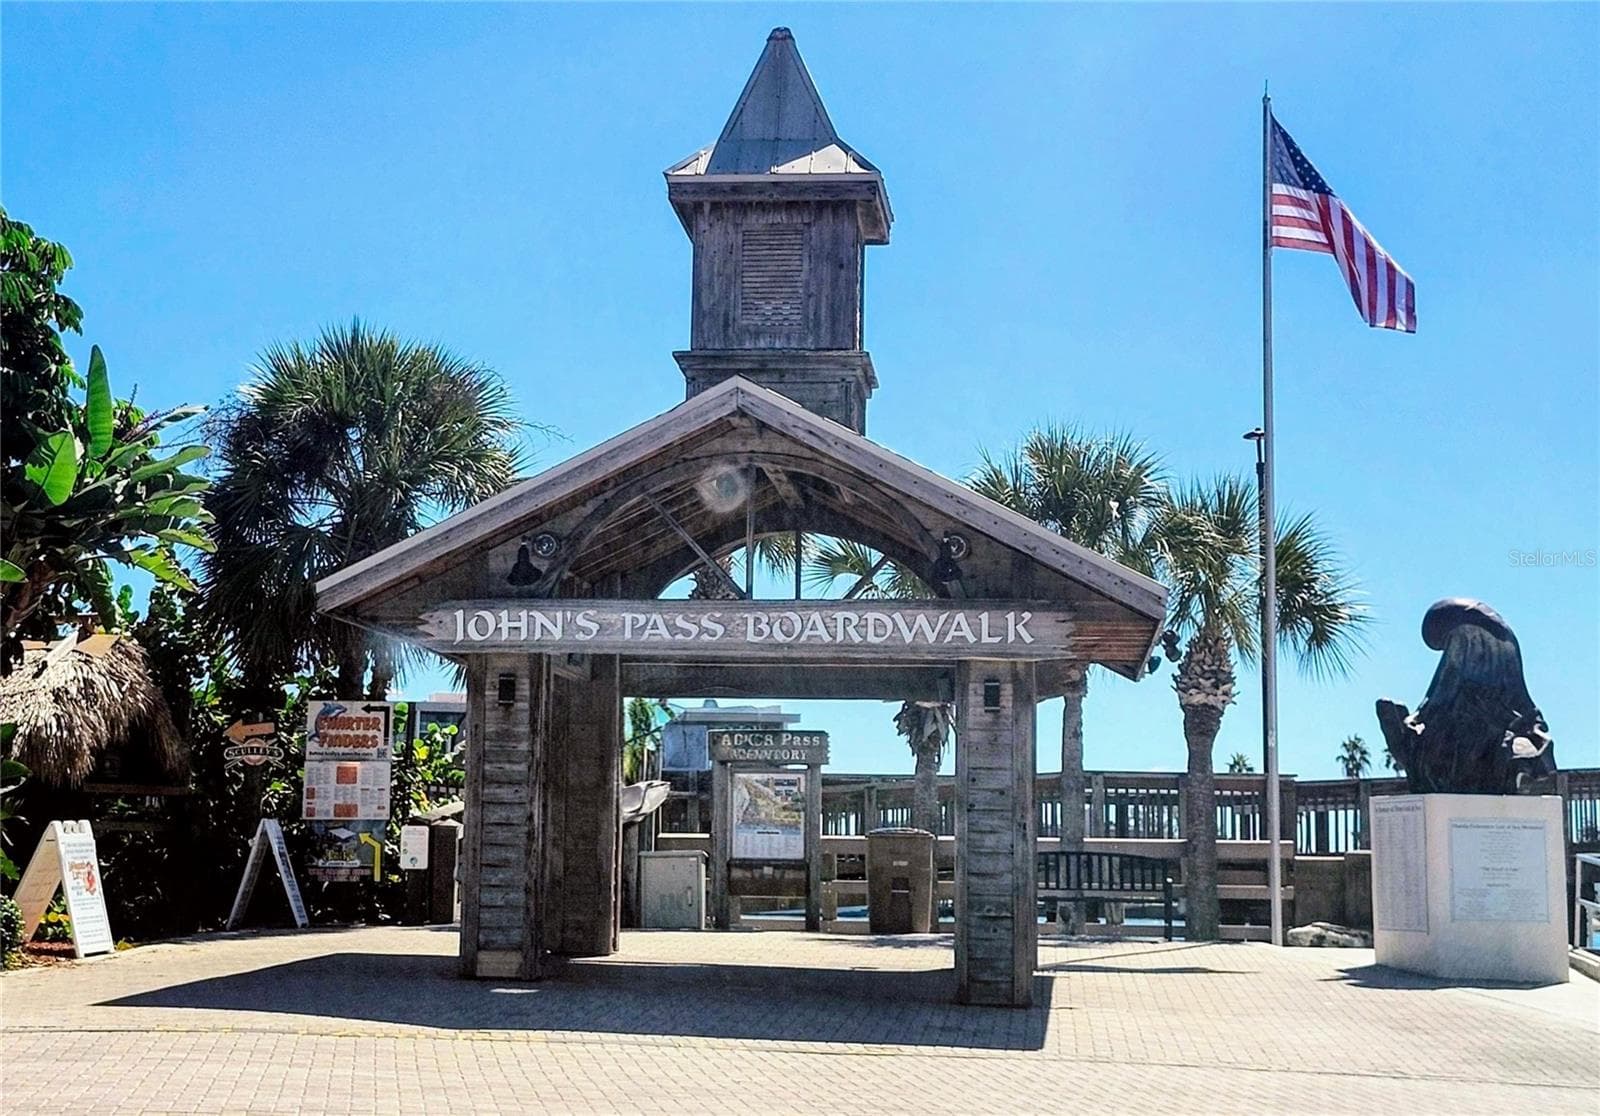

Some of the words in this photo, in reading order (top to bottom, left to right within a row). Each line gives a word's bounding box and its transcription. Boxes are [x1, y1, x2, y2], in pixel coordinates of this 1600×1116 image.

[453, 609, 600, 645] JOHN'S
[621, 612, 725, 641] PASS
[742, 611, 1035, 644] BOARDWALK
[319, 716, 381, 732] CHARTER
[319, 732, 379, 749] FINDERS
